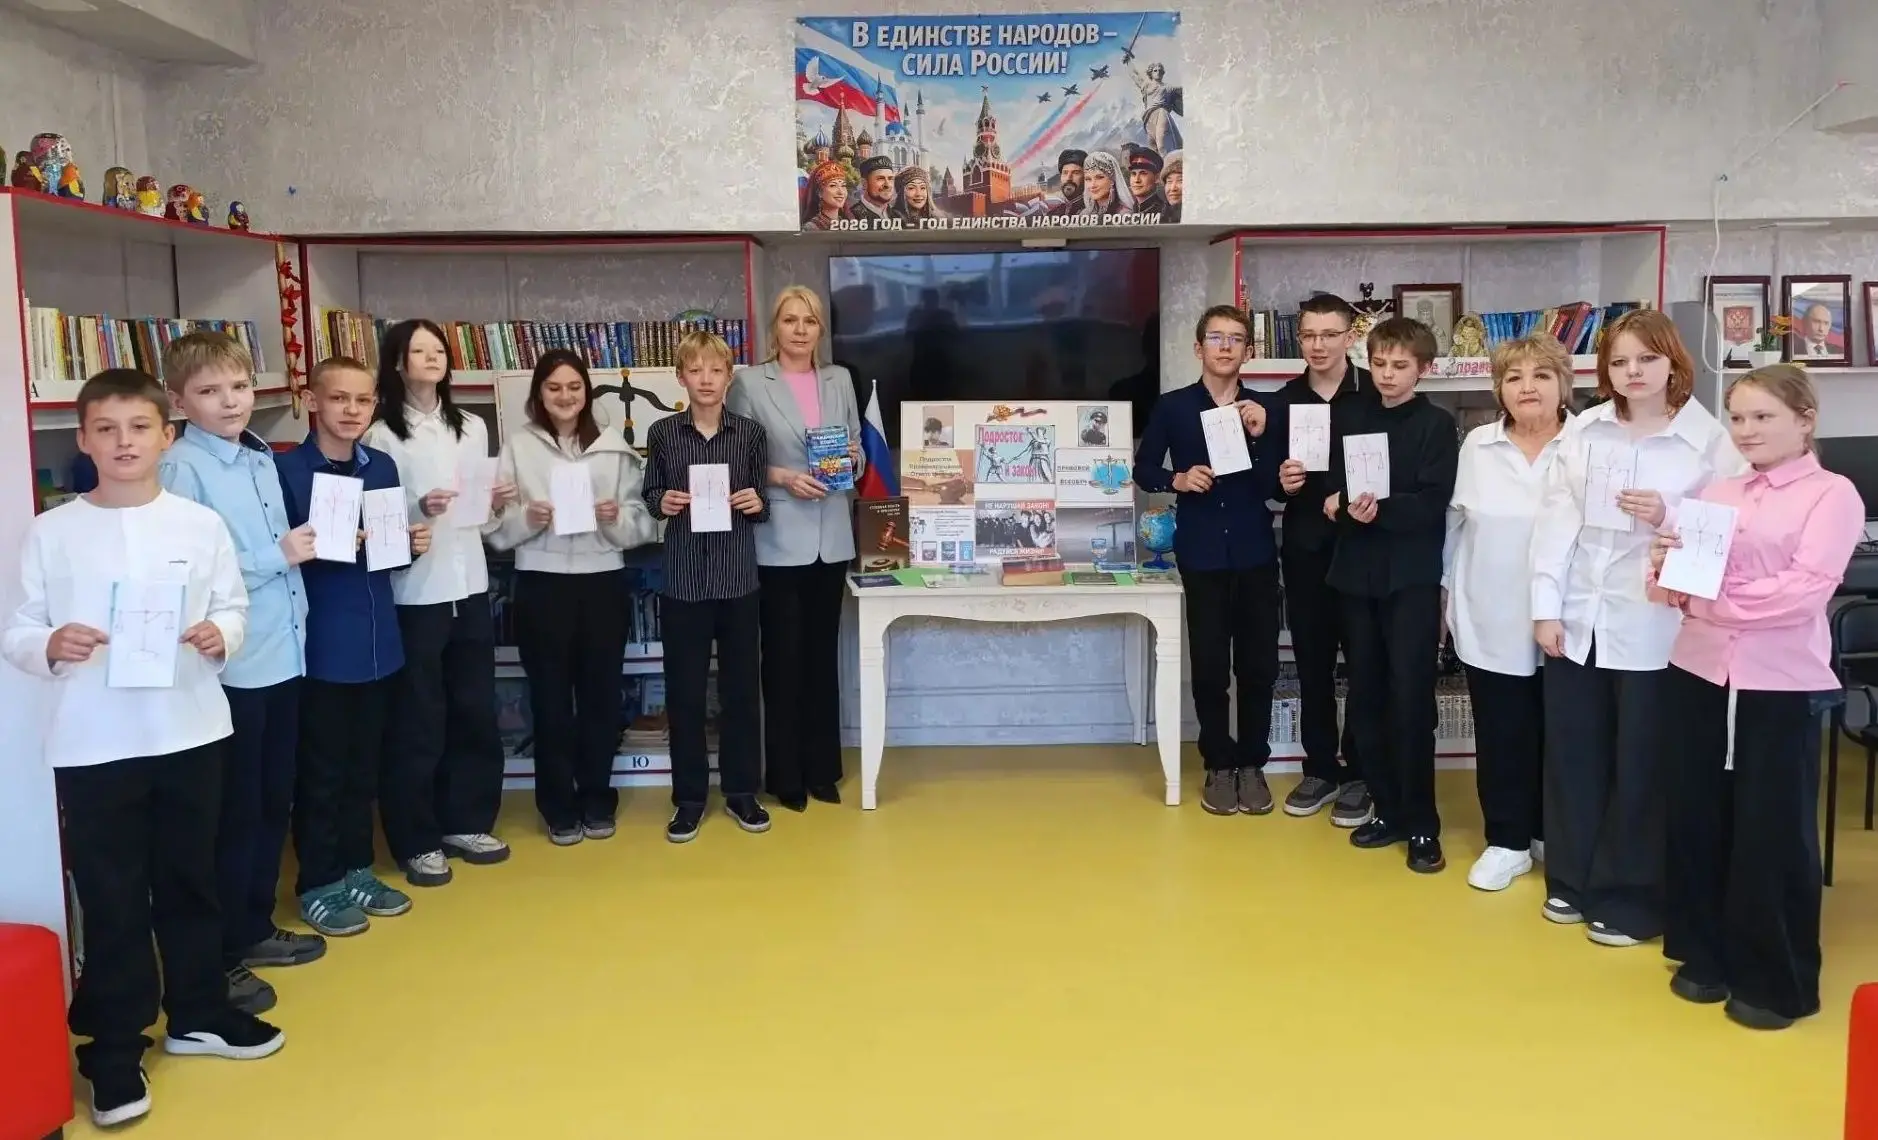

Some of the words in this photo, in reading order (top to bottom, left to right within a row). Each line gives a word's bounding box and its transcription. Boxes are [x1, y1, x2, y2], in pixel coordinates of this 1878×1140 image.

[852, 21, 870, 48] В
[877, 24, 993, 51] ЕДИНСТВЕ
[997, 23, 1100, 49] НАРОДОВ
[902, 52, 964, 76] СИЛА
[970, 49, 1068, 76] РОССИИ!
[829, 218, 869, 231] 2026
[872, 217, 903, 231] ГОД
[919, 217, 948, 230] ГОД
[951, 215, 1028, 230] ЕДИНСТВА
[1031, 214, 1099, 228] НАРОДОВ
[1102, 212, 1161, 226] РОССИИ
[30, 381, 40, 398] А
[978, 426, 1024, 445] Подросток
